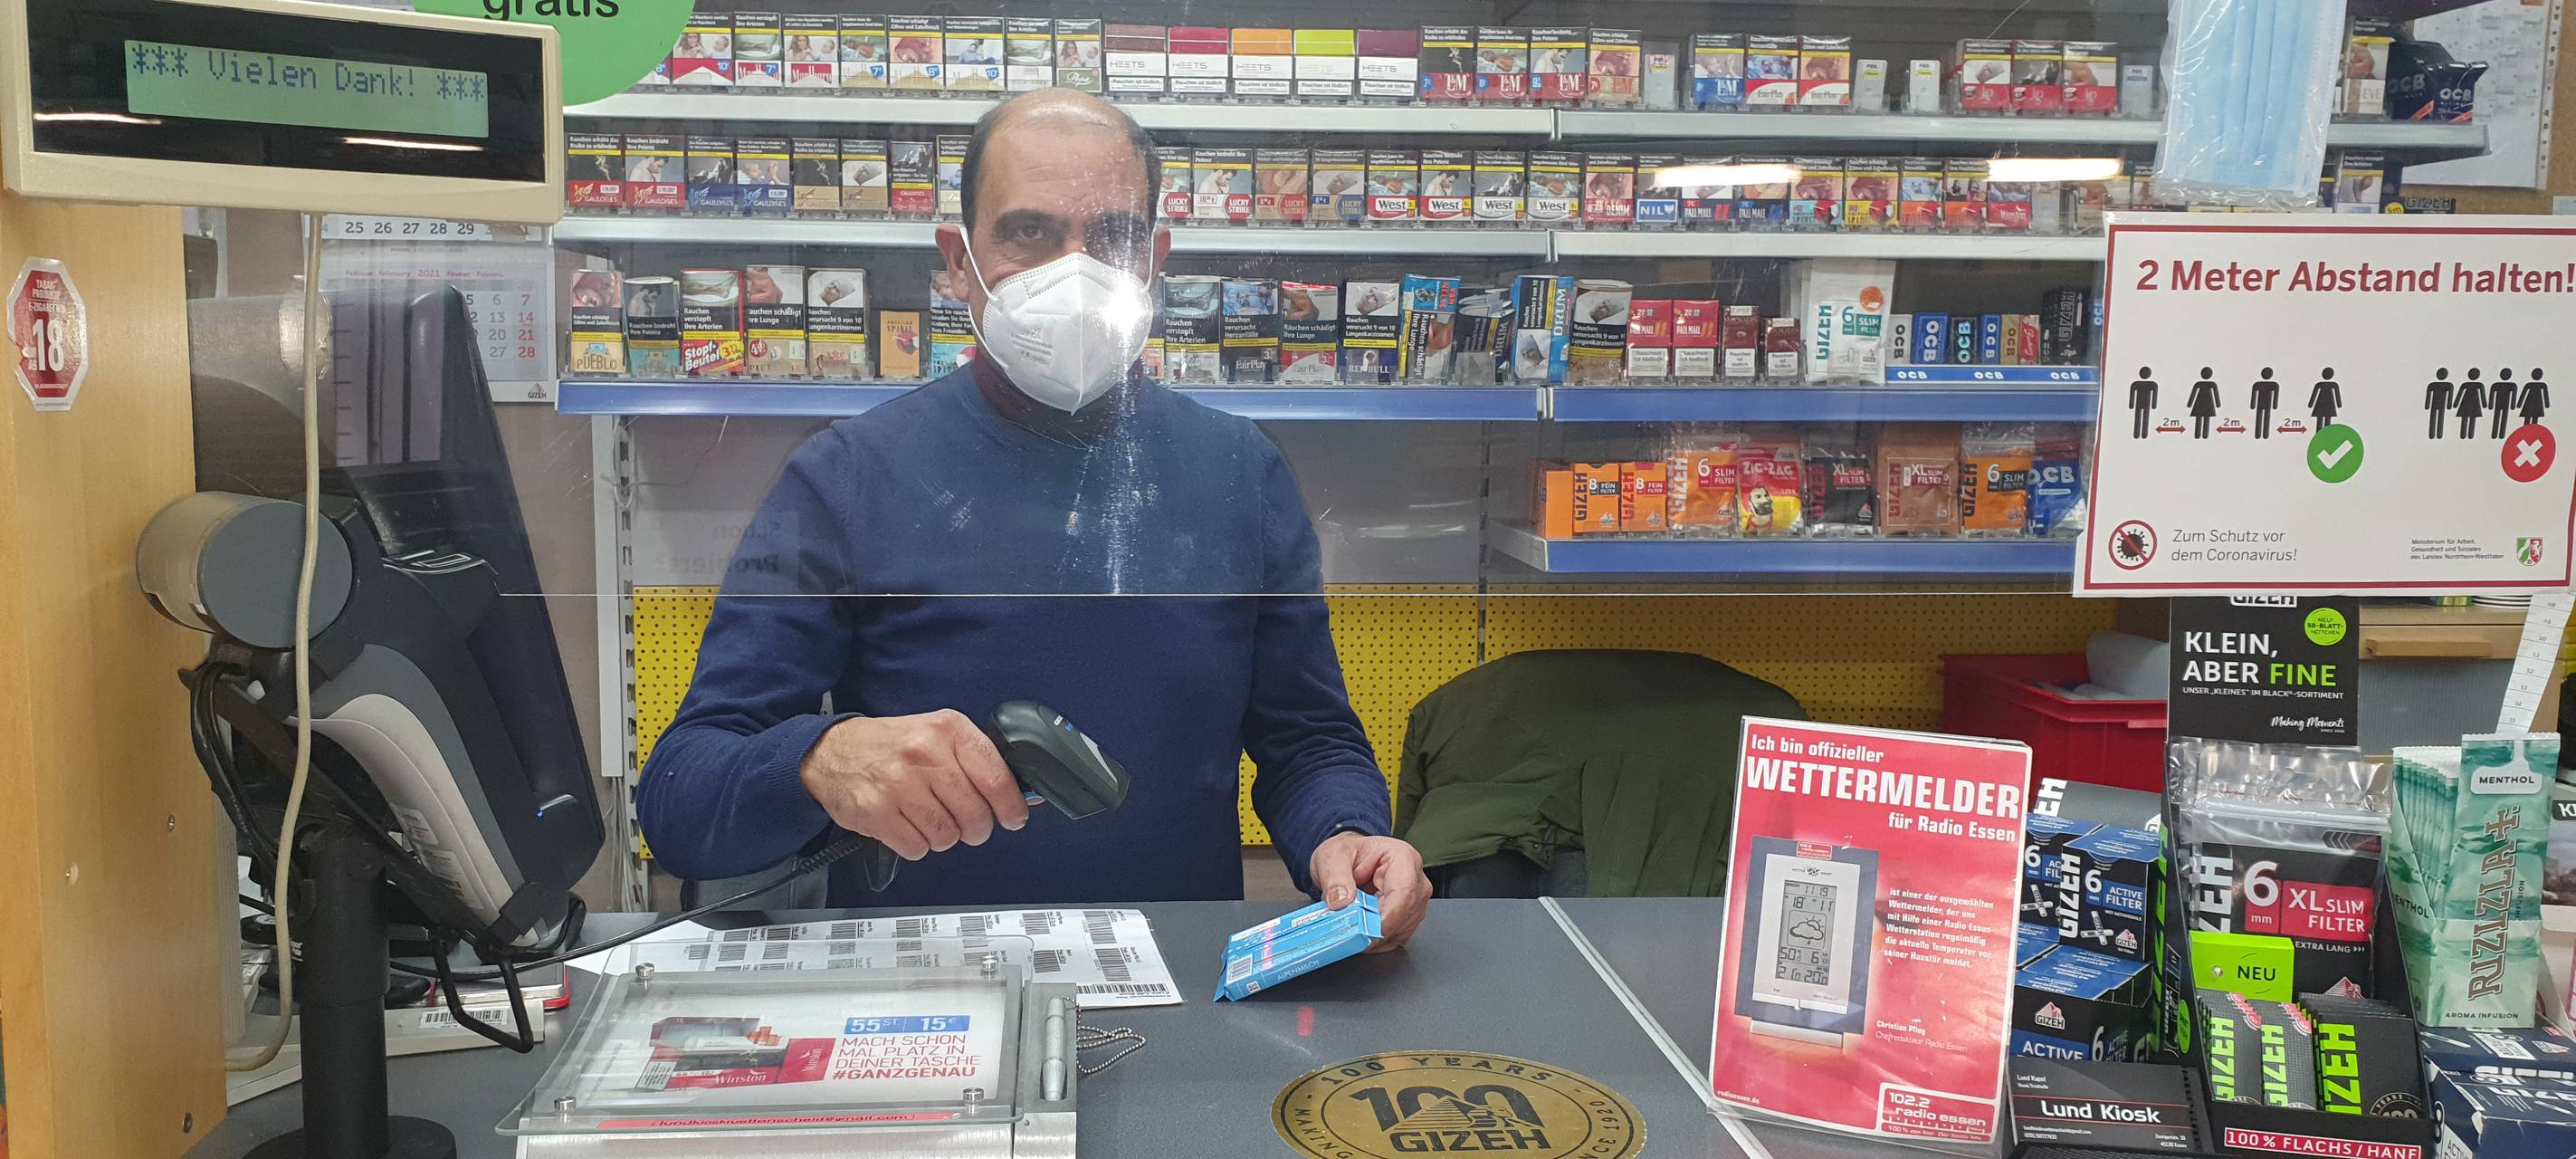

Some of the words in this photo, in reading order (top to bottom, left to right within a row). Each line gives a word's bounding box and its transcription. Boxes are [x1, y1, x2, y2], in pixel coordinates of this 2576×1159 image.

[482, 0, 620, 20] gratis
[1109, 61, 1145, 69] HEETS
[1362, 64, 1397, 72] HEETS
[207, 50, 318, 90] Vielen
[334, 62, 415, 97] Dank!
[2440, 88, 2472, 101] OCB
[1379, 198, 1407, 210] West
[1432, 198, 1459, 211] West
[1484, 199, 1512, 210] West
[1539, 200, 1567, 212] West
[1640, 204, 1665, 216] NIL
[345, 221, 364, 235] 25
[374, 221, 393, 235] 26
[402, 222, 420, 235] 27
[429, 223, 448, 235] 28
[457, 223, 475, 235] 29
[417, 269, 440, 278] 2021
[2136, 260, 2160, 291] 2
[2171, 260, 2280, 292] Meter
[2288, 262, 2440, 292] Abstand
[2451, 263, 2575, 293] halten!
[520, 294, 530, 306] 7
[1448, 287, 1456, 305] VAN
[489, 311, 506, 323] 13
[519, 311, 534, 323] 14
[1554, 288, 1568, 337] DRUM
[1165, 318, 1193, 327] Rauchen
[488, 329, 506, 340] 20
[518, 329, 535, 340] 21
[1165, 327, 1194, 336] verstopft
[1816, 305, 1832, 359] GIZEH
[32, 319, 64, 372] 18
[1894, 324, 1905, 359] OCB
[1923, 321, 1940, 361] OCB
[489, 346, 507, 358] 27
[518, 346, 536, 358] 28
[684, 342, 717, 361] Stopf-
[577, 354, 617, 370] PUEBLO
[685, 352, 720, 370] Beutel
[1897, 370, 1928, 379] OCB
[1974, 371, 2004, 379] OCB
[2050, 371, 2080, 380] OCB
[2161, 418, 2180, 426] 2m
[2223, 418, 2240, 426] 2m
[2285, 418, 2302, 426] 2m
[1714, 468, 1735, 477] SLIM
[1742, 462, 1793, 475] ZIG-ZAG
[1912, 464, 1926, 475] XL
[1987, 464, 1999, 481] 6
[2004, 474, 2024, 483] SLIM
[1589, 477, 1598, 490] 8
[1636, 477, 1644, 489] 8
[1575, 472, 1588, 522] GIZEH
[2172, 530, 2203, 543] Zum
[2209, 529, 2258, 543] Schutz
[2263, 532, 2285, 543] vor
[2171, 548, 2203, 561] dem
[2206, 548, 2297, 562] Coronavirus!
[2185, 631, 2278, 658] KLEIN,
[2182, 660, 2259, 684] ABER
[2270, 663, 2337, 686] FINE
[2271, 716, 2304, 731] Making
[2306, 716, 2345, 728] Moments
[1751, 734, 1776, 752] Ich
[1779, 736, 1804, 756] bin
[1808, 741, 1884, 763] offizieller
[1747, 756, 2022, 819] WETTERMELDER
[2478, 774, 2535, 785] MENTHOL
[1888, 811, 1913, 829] für
[1917, 815, 1963, 838] Radio
[1968, 820, 2017, 843] Essen
[2024, 845, 2041, 867] 6
[2109, 886, 2143, 900] ACTIVE
[2244, 860, 2280, 907] 6
[2289, 889, 2326, 910] XL
[2327, 898, 2364, 914] SLIM
[1890, 887, 1900, 896] ist
[1902, 889, 1922, 899] einer
[1924, 891, 1938, 901] der
[1939, 895, 1994, 909] ausgewählten
[2059, 853, 2081, 938] GIZEH
[2105, 895, 2142, 911] FILTER
[1888, 899, 1944, 915] Wettermelder,
[1961, 910, 1976, 918] uns
[1887, 913, 1900, 921] mit
[1902, 913, 1920, 924] Hilfe
[1944, 919, 1967, 930] Radio
[2250, 915, 2273, 924] mm
[2309, 916, 2365, 933] FILTER
[1886, 924, 1941, 939] Wetterstation
[1942, 932, 1987, 947] regelmäßig
[1884, 936, 1897, 945] die
[1898, 938, 1930, 949] aktuelle
[1932, 942, 1976, 955] Temperatur
[2295, 941, 2320, 952] EXTRA
[2323, 943, 2351, 953] LANG
[1884, 949, 1909, 959] seiner
[1910, 952, 1942, 963] Haustür
[1277, 959, 1320, 981] ALPENMILCH
[2237, 965, 2276, 982] NEU
[851, 1019, 882, 1032] 55
[1876, 1020, 1907, 1031] Christian
[2036, 1015, 2065, 1029] GIZEH
[842, 1037, 896, 1048] MACH
[902, 1034, 967, 1046] SCHON
[840, 1047, 880, 1058] MAL
[884, 1046, 940, 1057] PLATZ
[947, 1046, 965, 1056] IN
[835, 1057, 902, 1068] DEINER
[910, 1055, 980, 1067] TASCHE
[833, 1067, 976, 1080] #GANZGENAU
[1320, 1060, 1386, 1086] 100
[1411, 1056, 1553, 1082] YEARS
[715, 1073, 767, 1086] Winston
[1717, 1089, 1760, 1105] radioessen.de
[1889, 1092, 1931, 1108] 102.2
[1895, 1106, 1937, 1119] radio
[1939, 1114, 1987, 1126] essen
[2041, 1099, 2093, 1119] Lund
[2100, 1103, 2161, 1124] Kiosk
[1294, 1106, 1353, 1159] MAKING
[1390, 1129, 1551, 1153] GIZEH
[2227, 1131, 2258, 1146] 100
[2263, 1135, 2275, 1148] %
[2283, 1137, 2352, 1155] FLACHS
[2356, 1142, 2363, 1155] /
[2367, 1144, 2418, 1159] HANF
